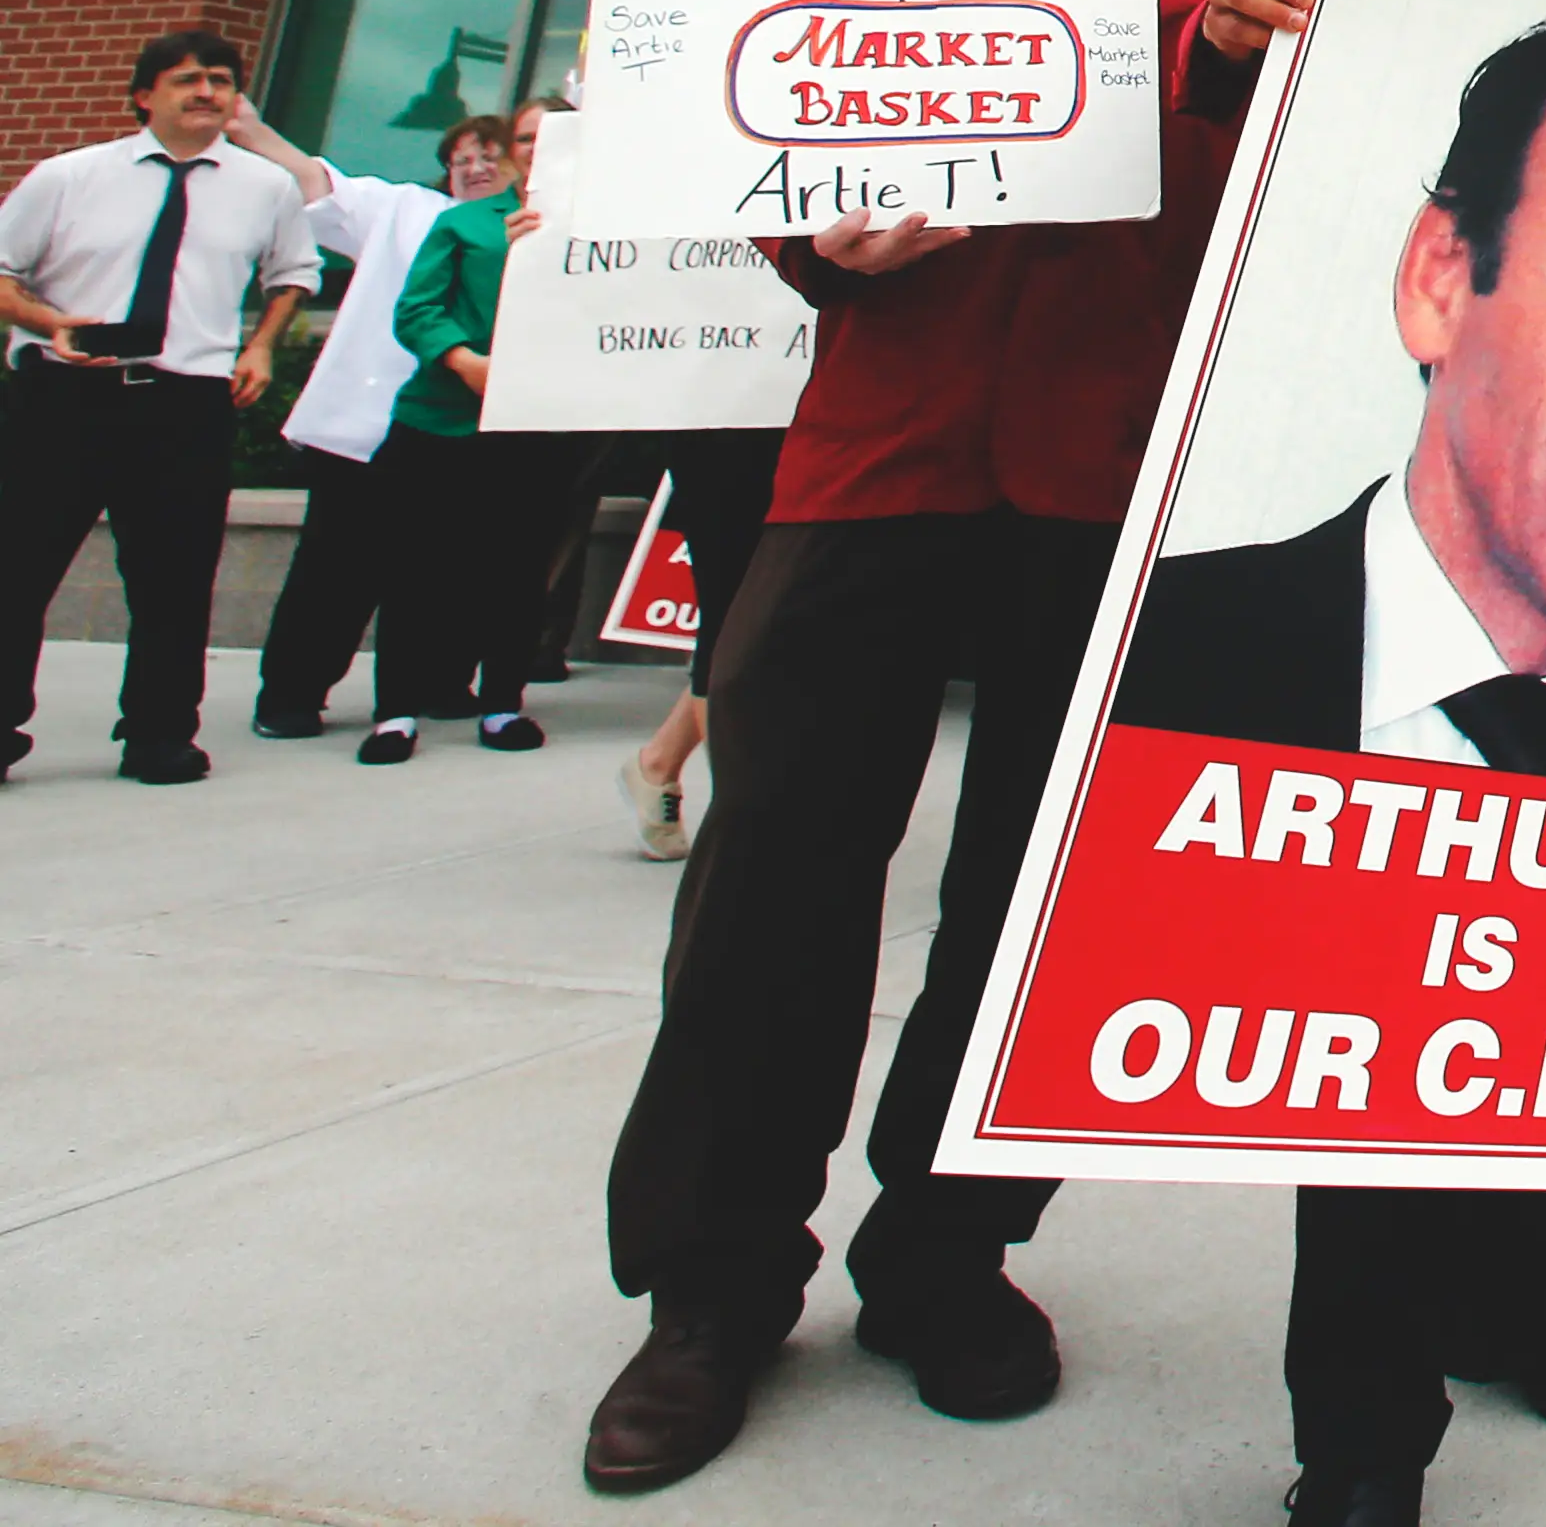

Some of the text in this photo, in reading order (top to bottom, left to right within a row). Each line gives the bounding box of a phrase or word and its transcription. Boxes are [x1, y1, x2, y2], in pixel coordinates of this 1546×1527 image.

[604, 5, 690, 30] Save
[1093, 18, 1141, 36] Save
[611, 36, 685, 58] Artie
[773, 15, 1052, 68] MARKET
[795, 82, 1041, 128] BASKET
[736, 150, 906, 223] Artie
[565, 238, 637, 274] END
[598, 325, 686, 354] BRING
[699, 325, 762, 350] BACK
[645, 598, 701, 631] OU
[1421, 913, 1519, 992] IS
[1089, 998, 1382, 1113] OUR
